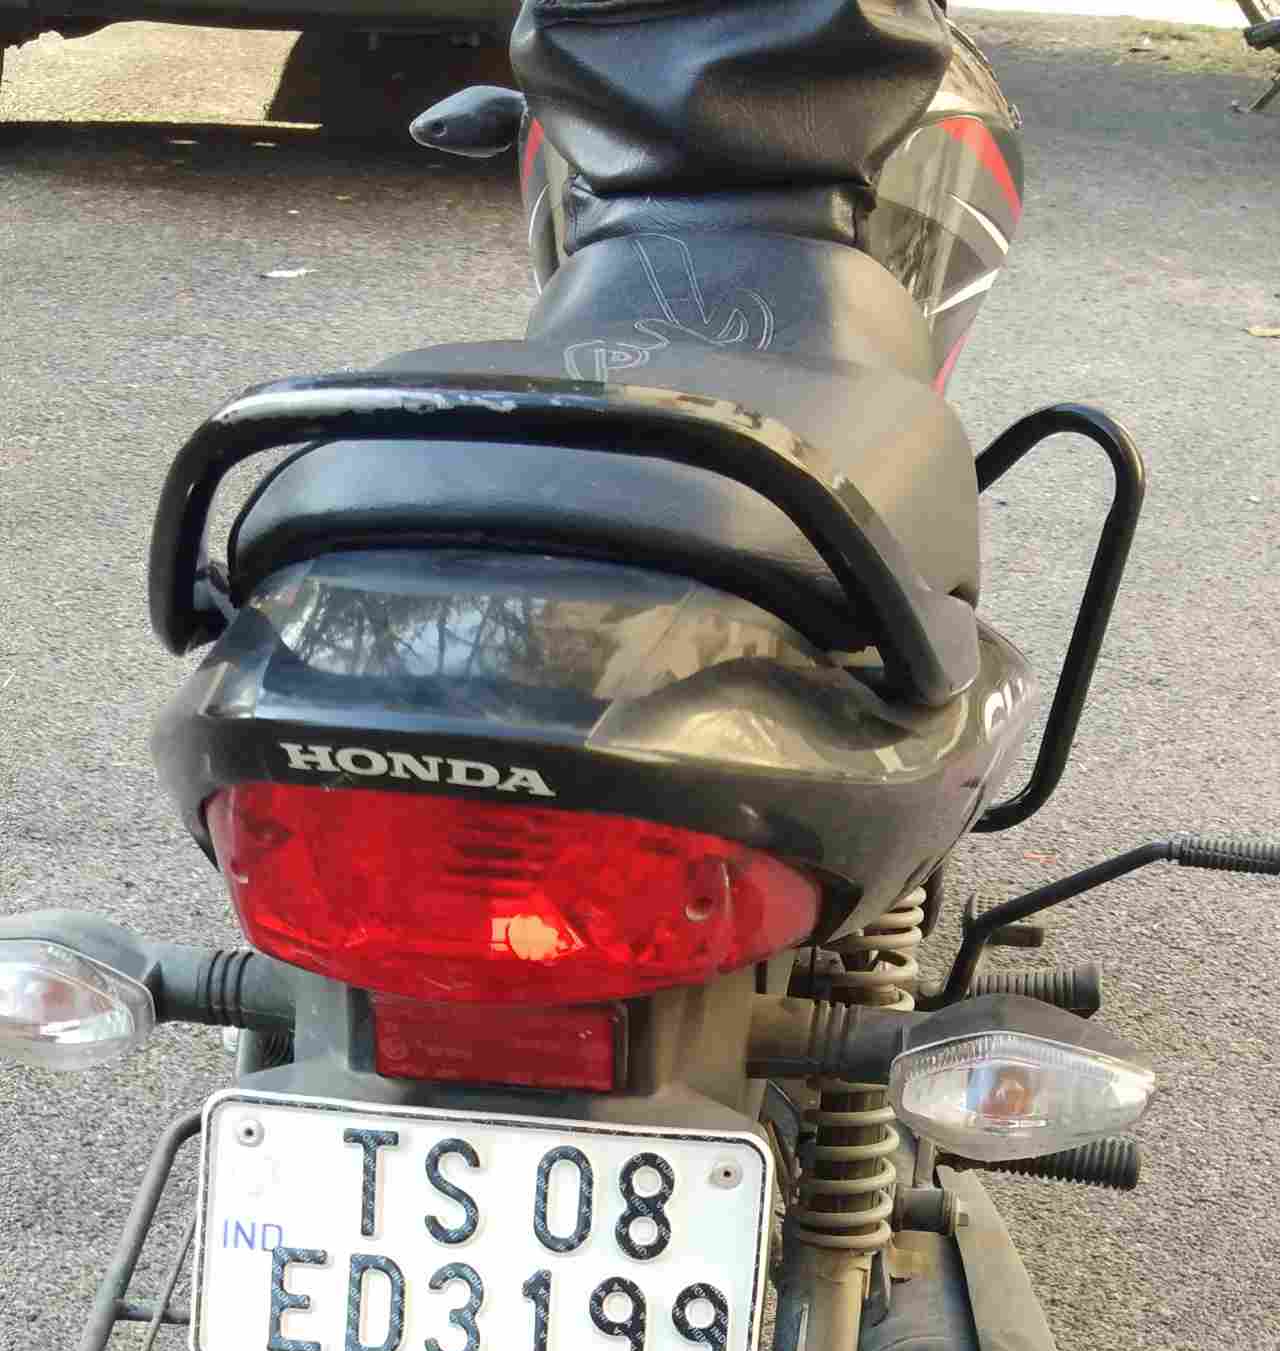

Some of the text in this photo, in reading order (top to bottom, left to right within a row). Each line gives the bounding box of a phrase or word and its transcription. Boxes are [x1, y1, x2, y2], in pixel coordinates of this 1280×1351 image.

[279, 742, 557, 797] HONDA
[343, 1127, 675, 1261] TS 08
[223, 1218, 284, 1252] IND
